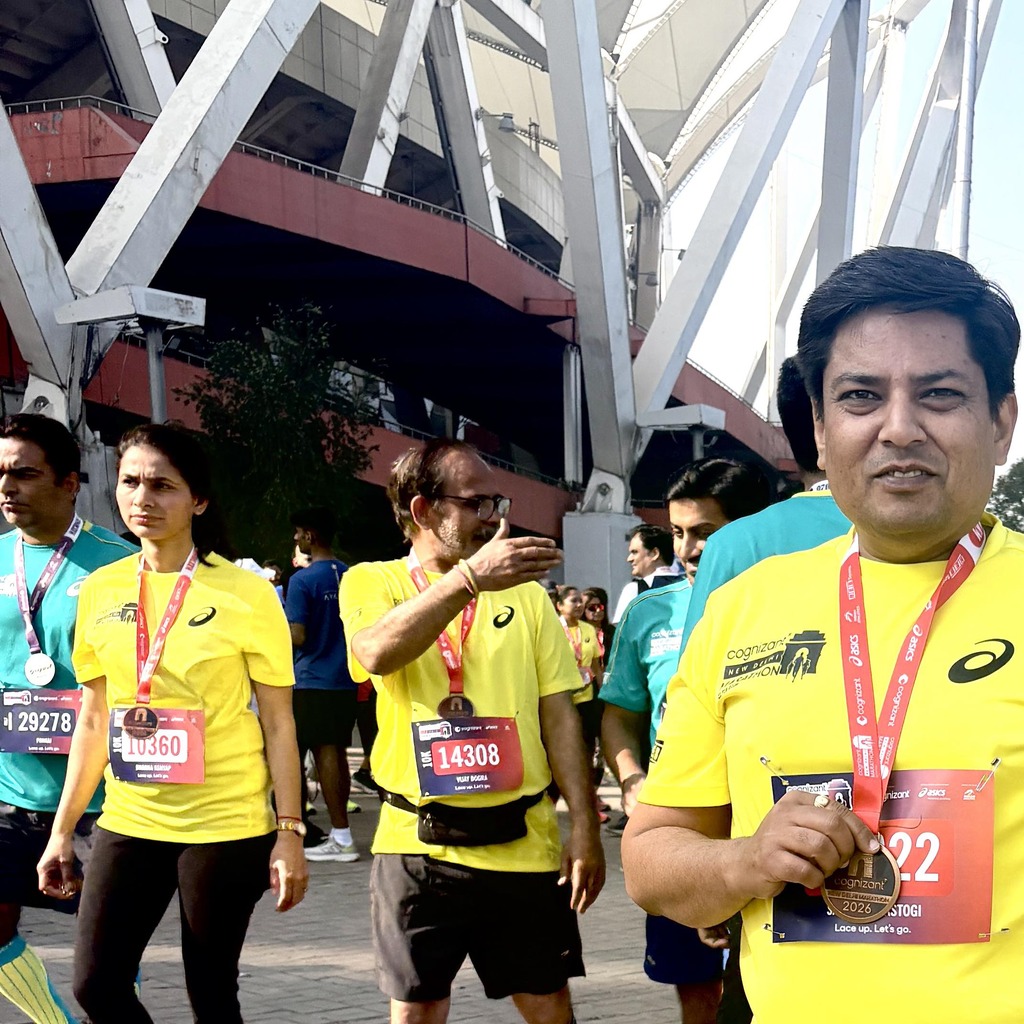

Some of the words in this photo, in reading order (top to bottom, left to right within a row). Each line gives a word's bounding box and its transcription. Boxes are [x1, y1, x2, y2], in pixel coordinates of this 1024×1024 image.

[850, 634, 860, 656] asics
[905, 636, 918, 662] asics
[728, 665, 749, 676] NEW
[854, 678, 866, 714] cognizant
[888, 685, 904, 727] cognizant
[18, 711, 72, 733] 29278
[113, 737, 123, 754] 10K
[128, 735, 181, 756] 10360
[421, 750, 433, 768] 10K
[438, 743, 500, 769] 14308
[884, 790, 910, 802] nizant
[927, 789, 946, 797] asics
[881, 831, 940, 881] 22
[835, 878, 885, 891] cognizant
[842, 901, 872, 914] 2026
[888, 904, 922, 917] STOGI
[834, 923, 856, 933] Lace
[858, 925, 873, 934] up.
[874, 923, 894, 933] Let's
[896, 927, 911, 935] go.
